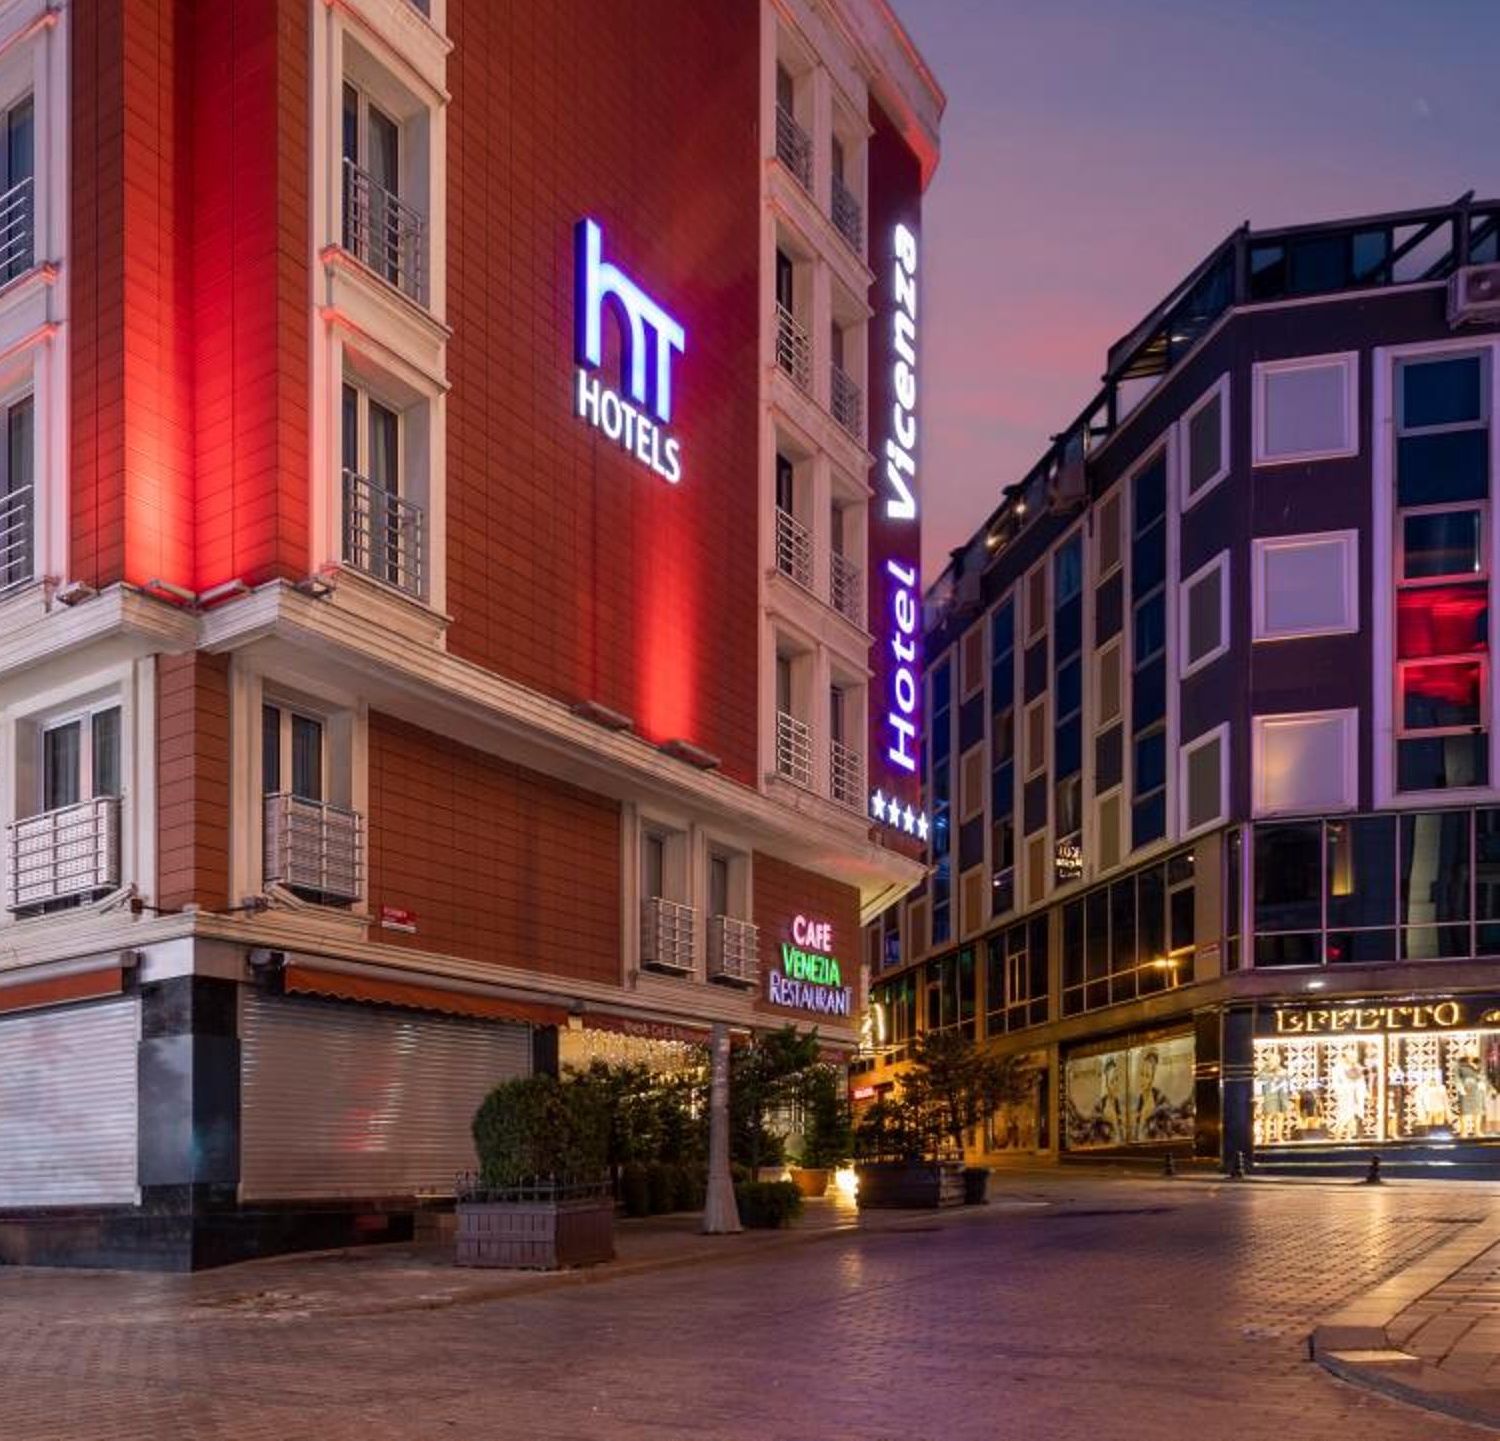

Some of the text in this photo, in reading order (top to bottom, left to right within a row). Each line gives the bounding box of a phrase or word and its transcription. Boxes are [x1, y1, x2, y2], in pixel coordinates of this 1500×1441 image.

[579, 369, 681, 484] HOTELS
[886, 223, 917, 772] Hotel Vicenza
[793, 914, 832, 952] CAFE
[782, 942, 841, 988] VENEZIA
[769, 968, 852, 1017] RESTAURANT
